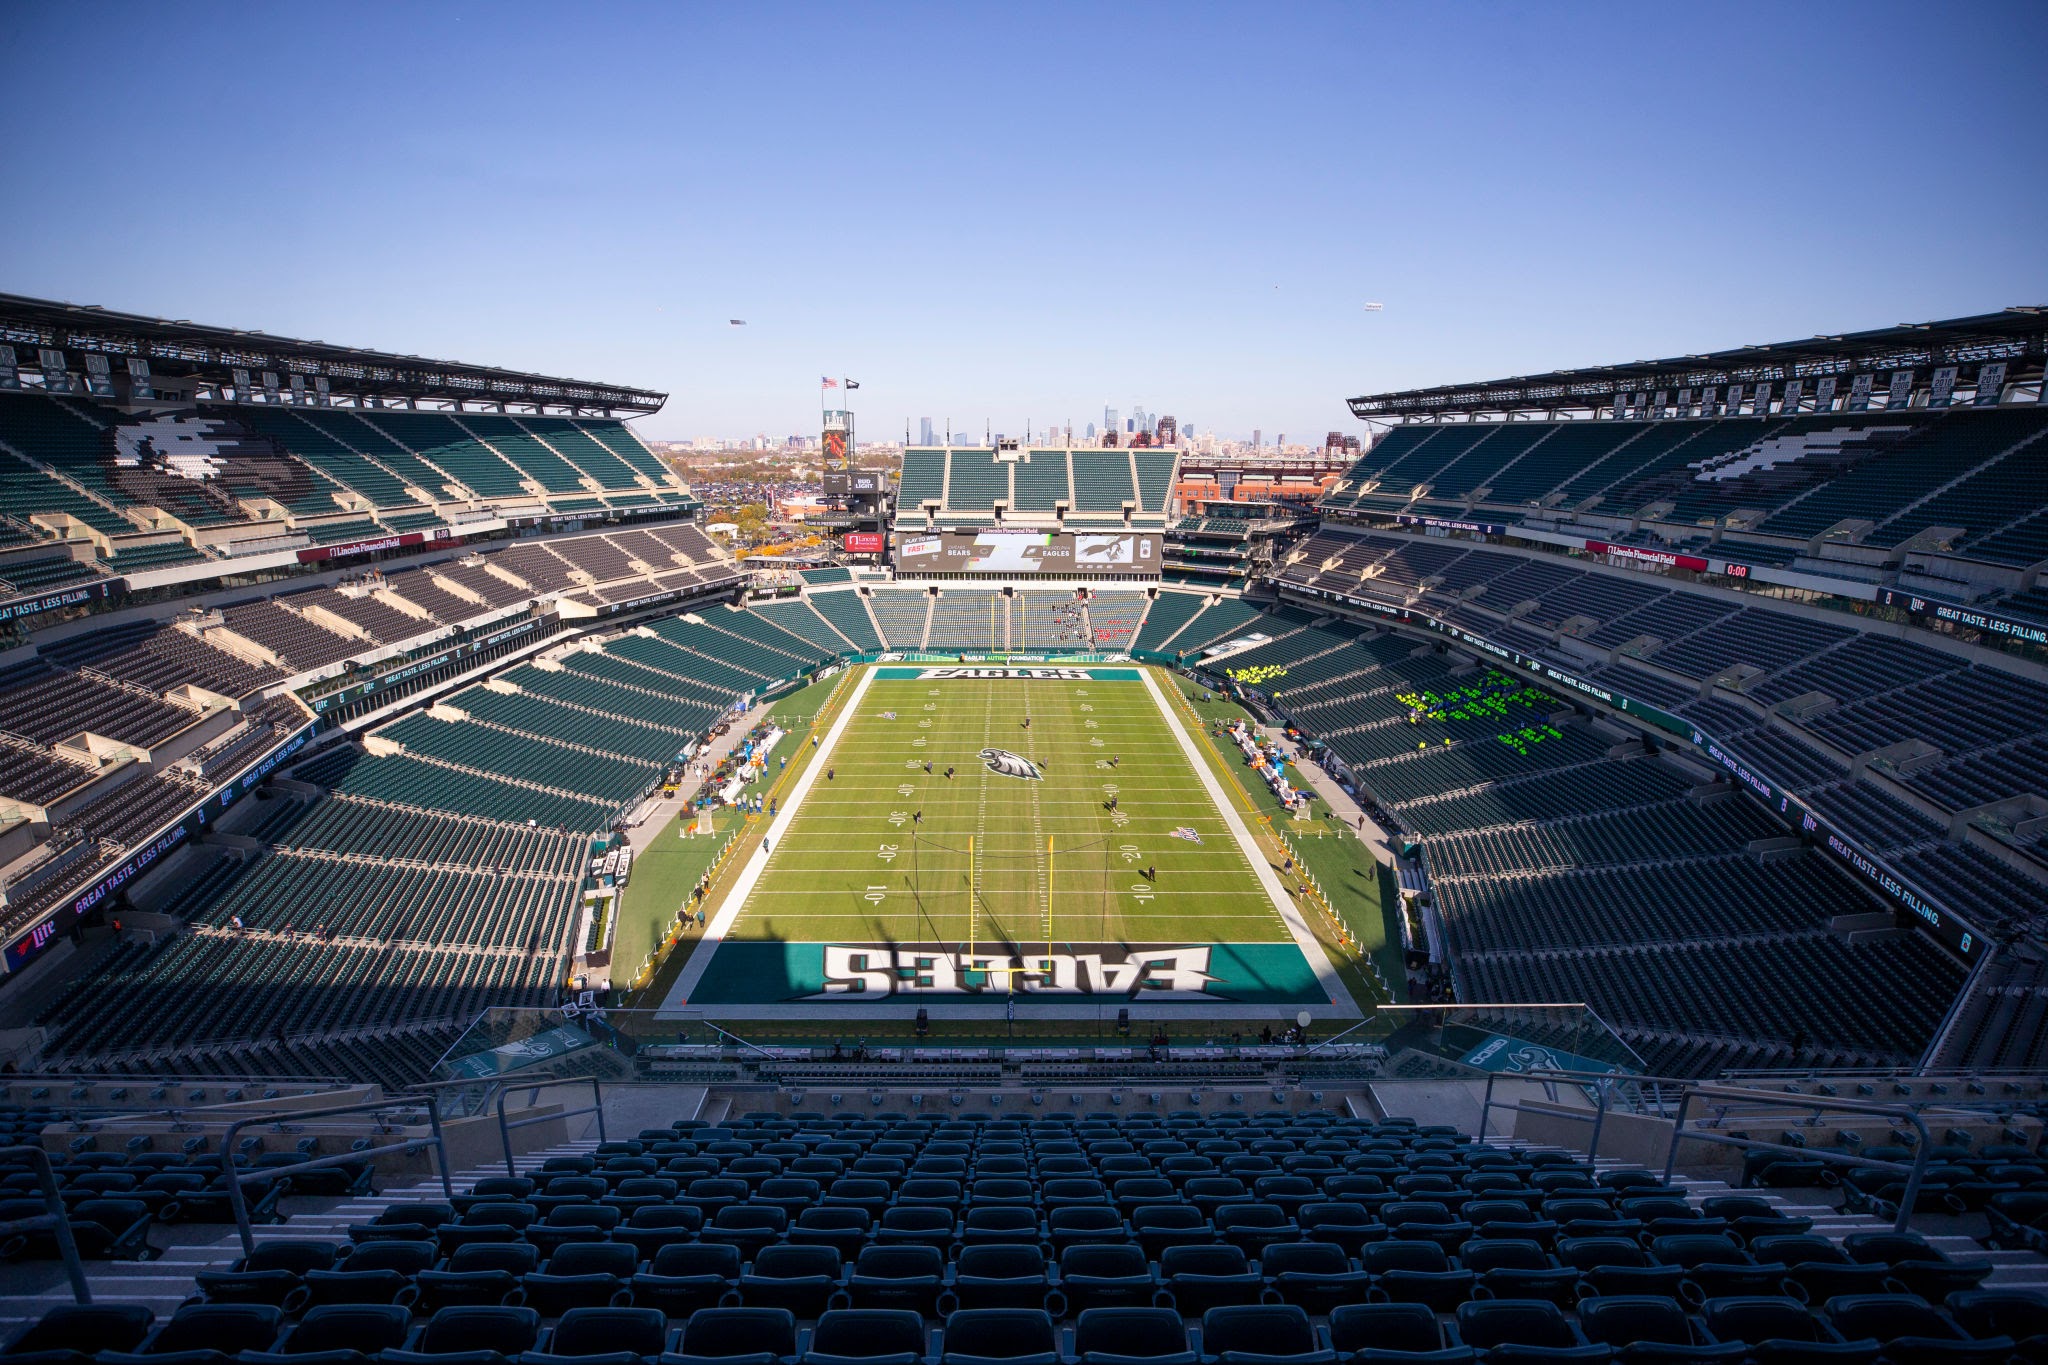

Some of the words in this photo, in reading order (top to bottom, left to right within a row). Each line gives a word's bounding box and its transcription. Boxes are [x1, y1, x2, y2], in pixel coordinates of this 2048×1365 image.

[1934, 379, 1952, 387] 2010
[1981, 375, 2000, 384] 2013
[436, 530, 448, 538] 0:00
[336, 545, 360, 556] Lincoln
[360, 540, 385, 552] Financial
[386, 538, 400, 548] Field
[908, 545, 925, 553] FAST
[1614, 546, 1634, 558] Lincoln
[1634, 550, 1660, 562] Financial
[1660, 554, 1676, 565] Field
[1728, 564, 1746, 577] 0:00
[14, 602, 42, 616] TASTE.
[42, 596, 61, 609] LESS
[62, 590, 90, 604] FILLING.
[1911, 598, 1925, 611] Lite
[1937, 607, 1961, 620] GREAT
[1962, 612, 1987, 627] TASTE.
[1989, 620, 2010, 633] LESS
[2011, 626, 2048, 644] FILLING.
[385, 673, 400, 684] GREAT
[402, 667, 418, 679] TASTE.
[418, 661, 431, 672] LESS
[431, 655, 448, 667] FILLING.
[916, 668, 1094, 680] EAGLES
[364, 682, 375, 693] Lite
[1548, 669, 1562, 680] GREAT
[1562, 675, 1578, 687] TASTE.
[1578, 682, 1591, 692] LESS
[1591, 687, 1612, 701] FILLING.
[316, 698, 328, 712] Lite
[243, 770, 260, 788] GREAT
[260, 758, 276, 774] TASTE.
[276, 750, 288, 761] LESS
[1709, 745, 1722, 760] GREAT
[1723, 755, 1738, 772] TASTE.
[1738, 767, 1750, 781] LESS
[1750, 777, 1771, 798] FILLING.
[646, 774, 661, 795] EAGLES
[220, 788, 232, 806] Lite
[1803, 813, 1817, 831] Lite
[878, 844, 898, 857] 20
[1120, 845, 1142, 859] 20
[75, 884, 107, 914] GREAT
[107, 864, 137, 889] TASTE.
[137, 849, 158, 868] LESS
[157, 825, 187, 853] FILLING.
[1828, 835, 1852, 858] GREAT
[1852, 853, 1878, 880] TASTE.
[1880, 874, 1901, 897] LESS
[1902, 890, 1940, 927] FILLING.
[864, 886, 887, 900] 10
[1131, 885, 1154, 900] 10
[31, 920, 56, 949] Lite
[822, 945, 1231, 1000] EAGLES
[1469, 1039, 1508, 1065] GEICO
